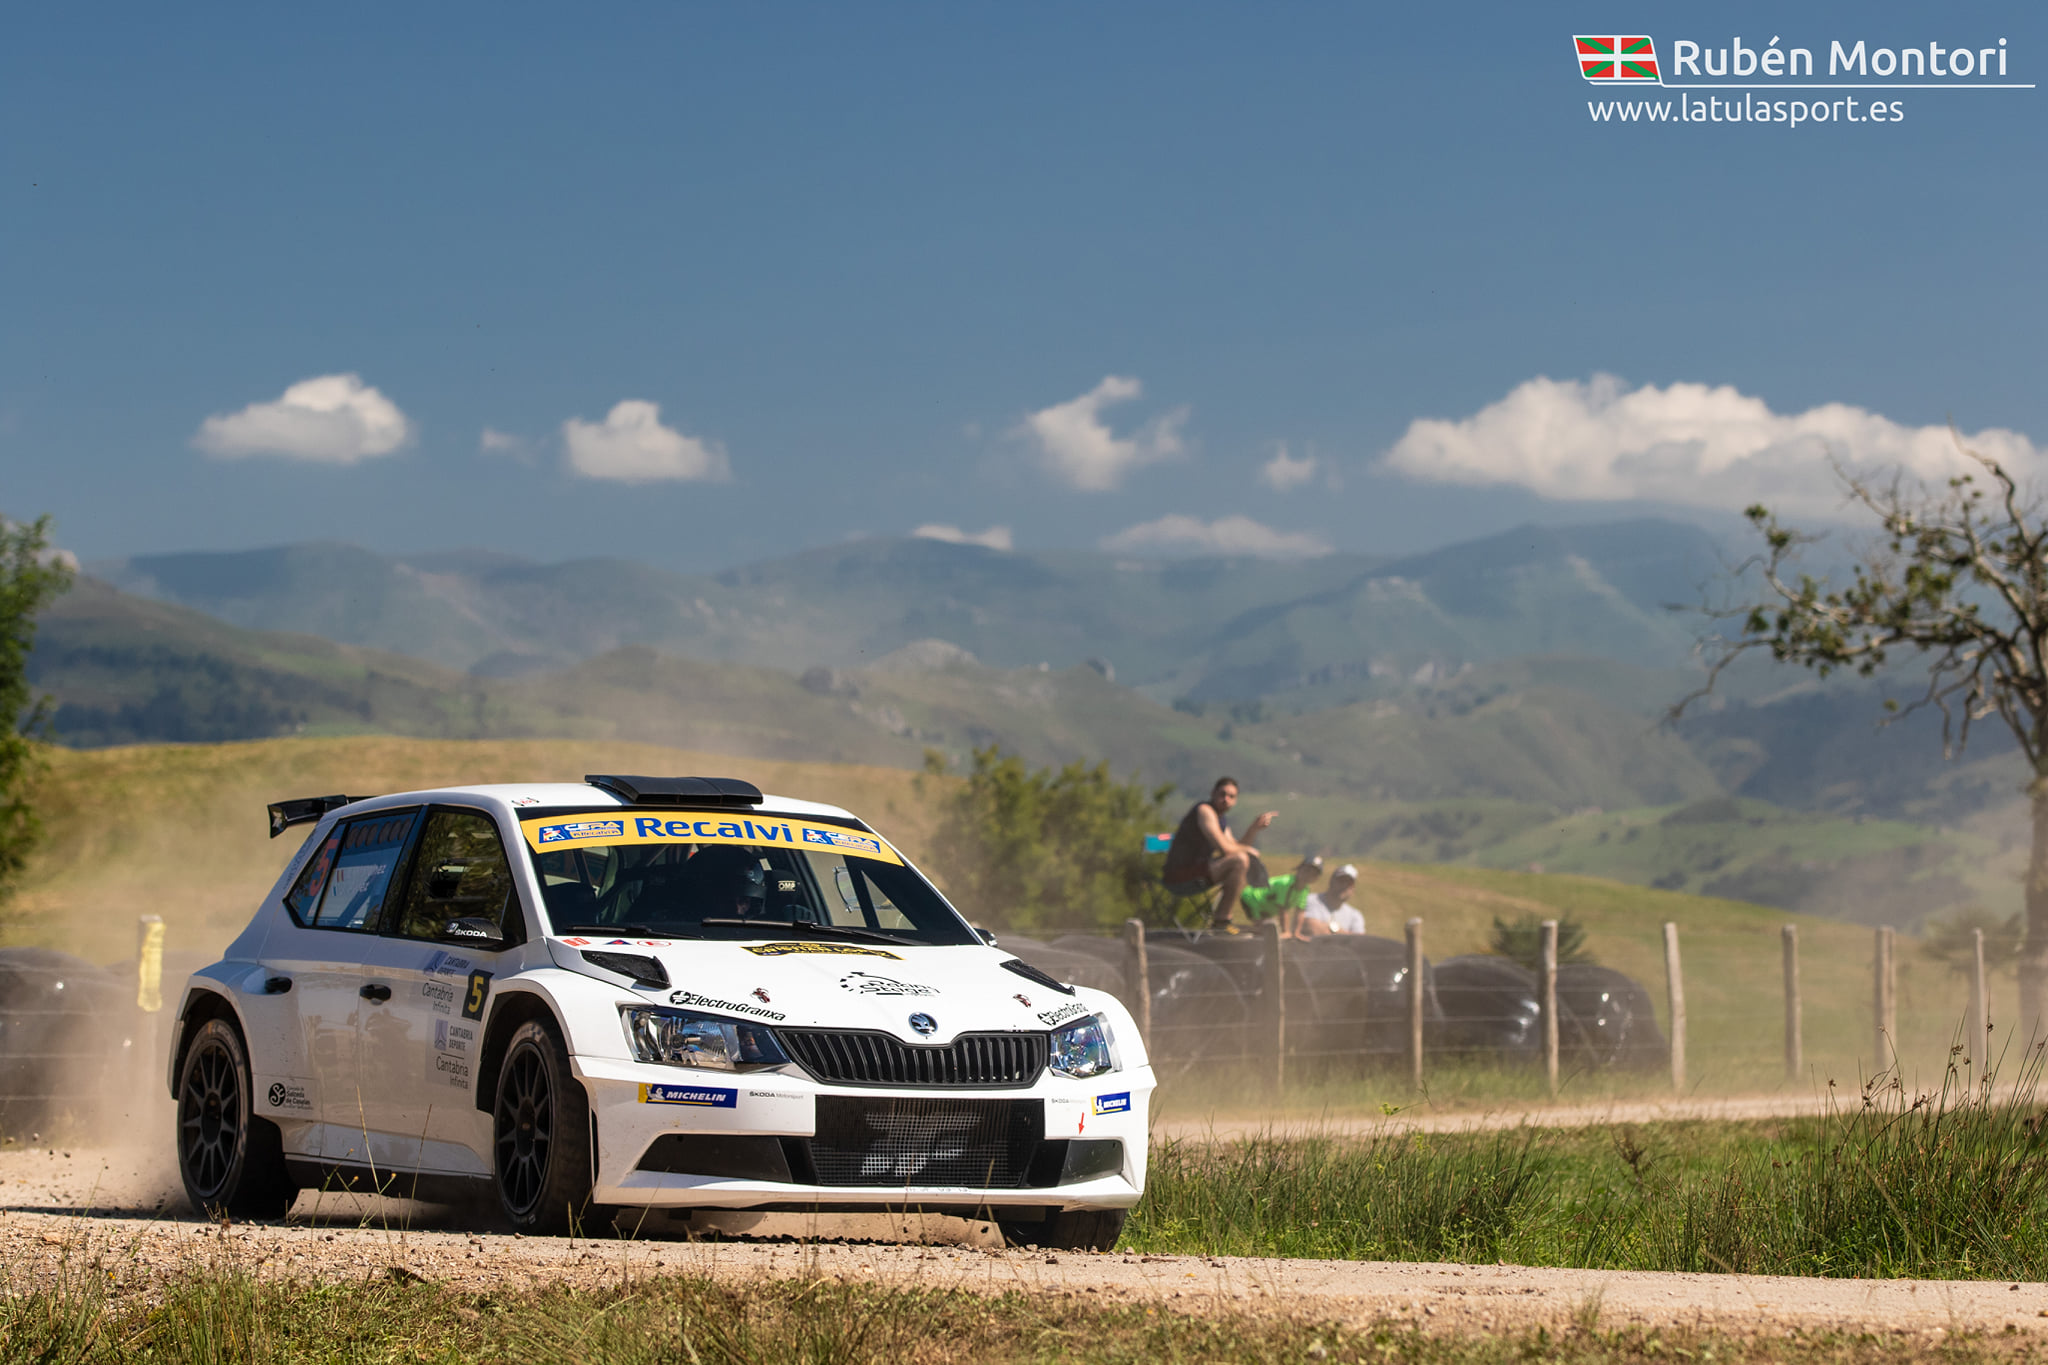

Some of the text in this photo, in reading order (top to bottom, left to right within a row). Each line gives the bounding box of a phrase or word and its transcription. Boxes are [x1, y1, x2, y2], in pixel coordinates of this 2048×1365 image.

[634, 817, 794, 843] Recalvi
[778, 882, 796, 890] OMP
[422, 982, 454, 1002] Cantabria
[468, 975, 484, 1013] 5
[686, 993, 786, 1021] ElectroGranxa
[435, 1055, 469, 1077] Cantabria
[666, 1091, 727, 1102] MICHELIN
